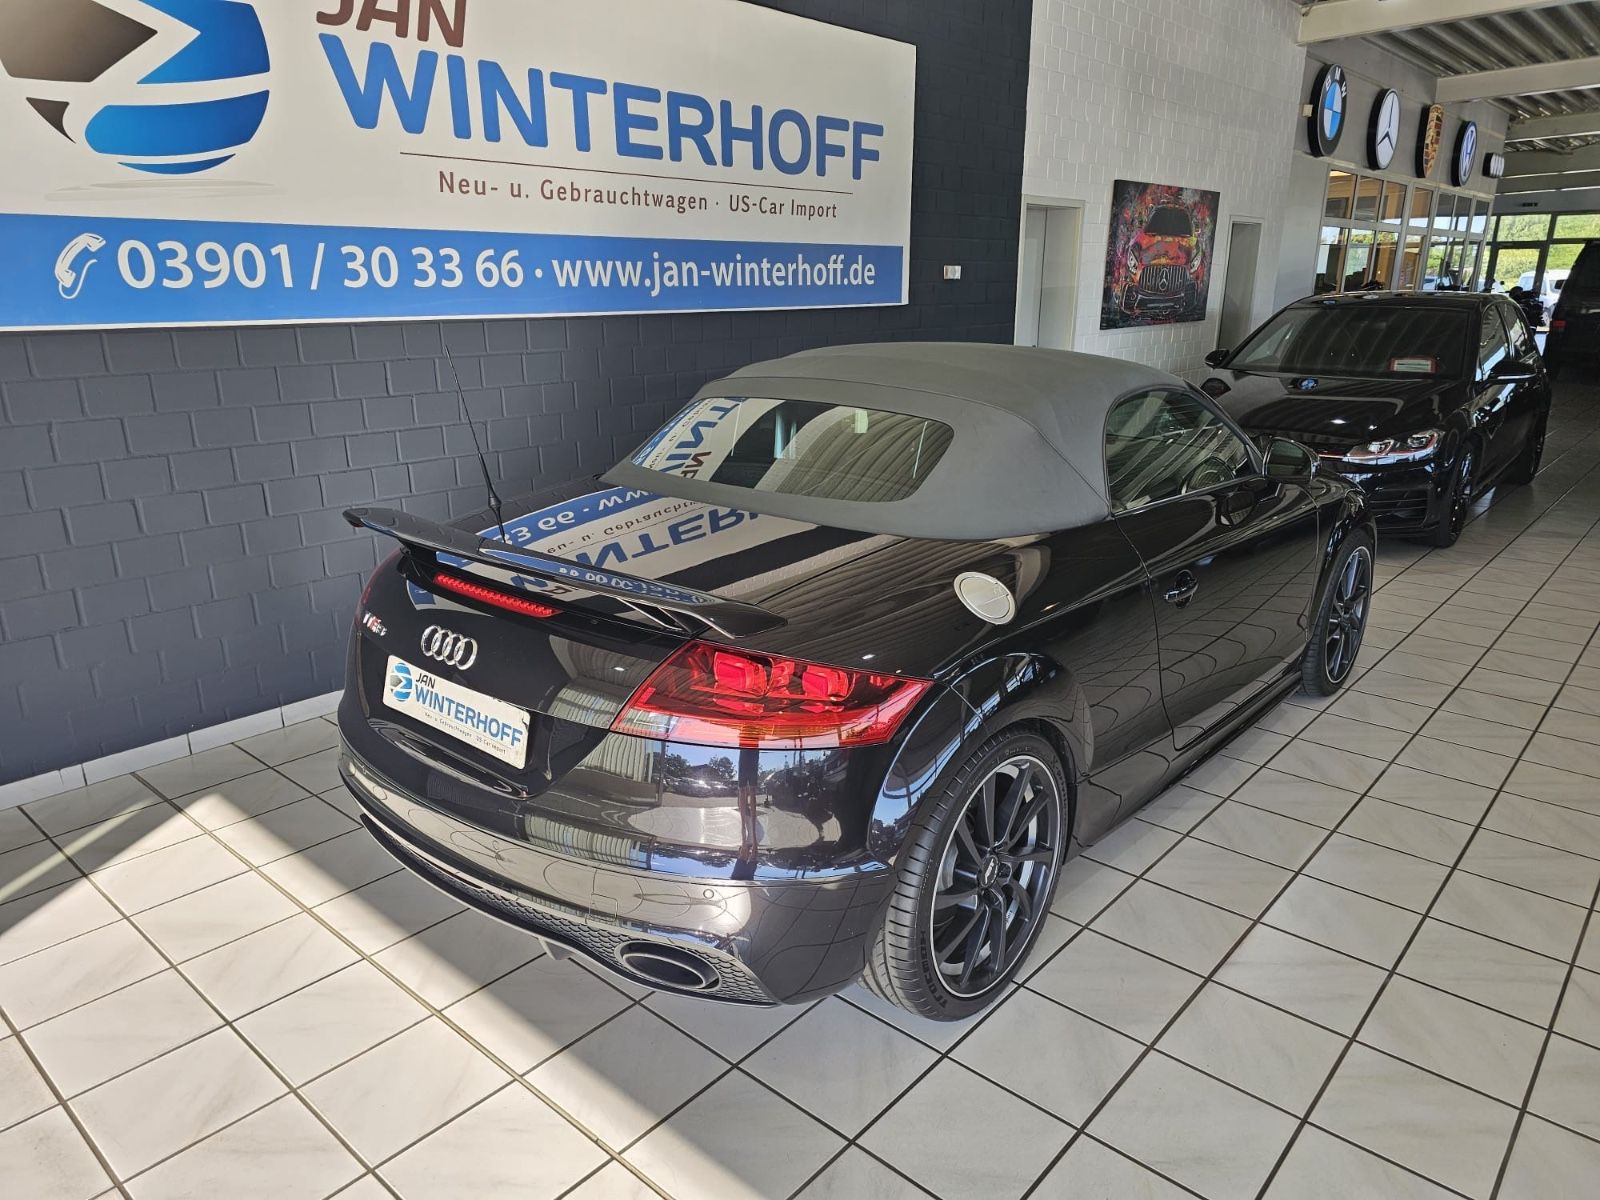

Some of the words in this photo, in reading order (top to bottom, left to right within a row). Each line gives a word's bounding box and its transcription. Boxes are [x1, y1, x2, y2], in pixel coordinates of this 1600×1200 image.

[318, 33, 884, 180] WINTERHOFF
[439, 171, 499, 195] Neu-
[510, 182, 530, 199] u.
[540, 179, 708, 213] Gebrauchtwagen
[728, 194, 785, 216] US-Car
[790, 199, 838, 222] Import
[117, 239, 294, 289] 03901
[340, 245, 399, 289] 30
[412, 247, 464, 288] 33
[475, 250, 524, 288] 66
[552, 252, 876, 297] www.jan-winterhoff.de
[415, 672, 436, 690] JAN
[414, 684, 524, 747] WINTERHOFF
